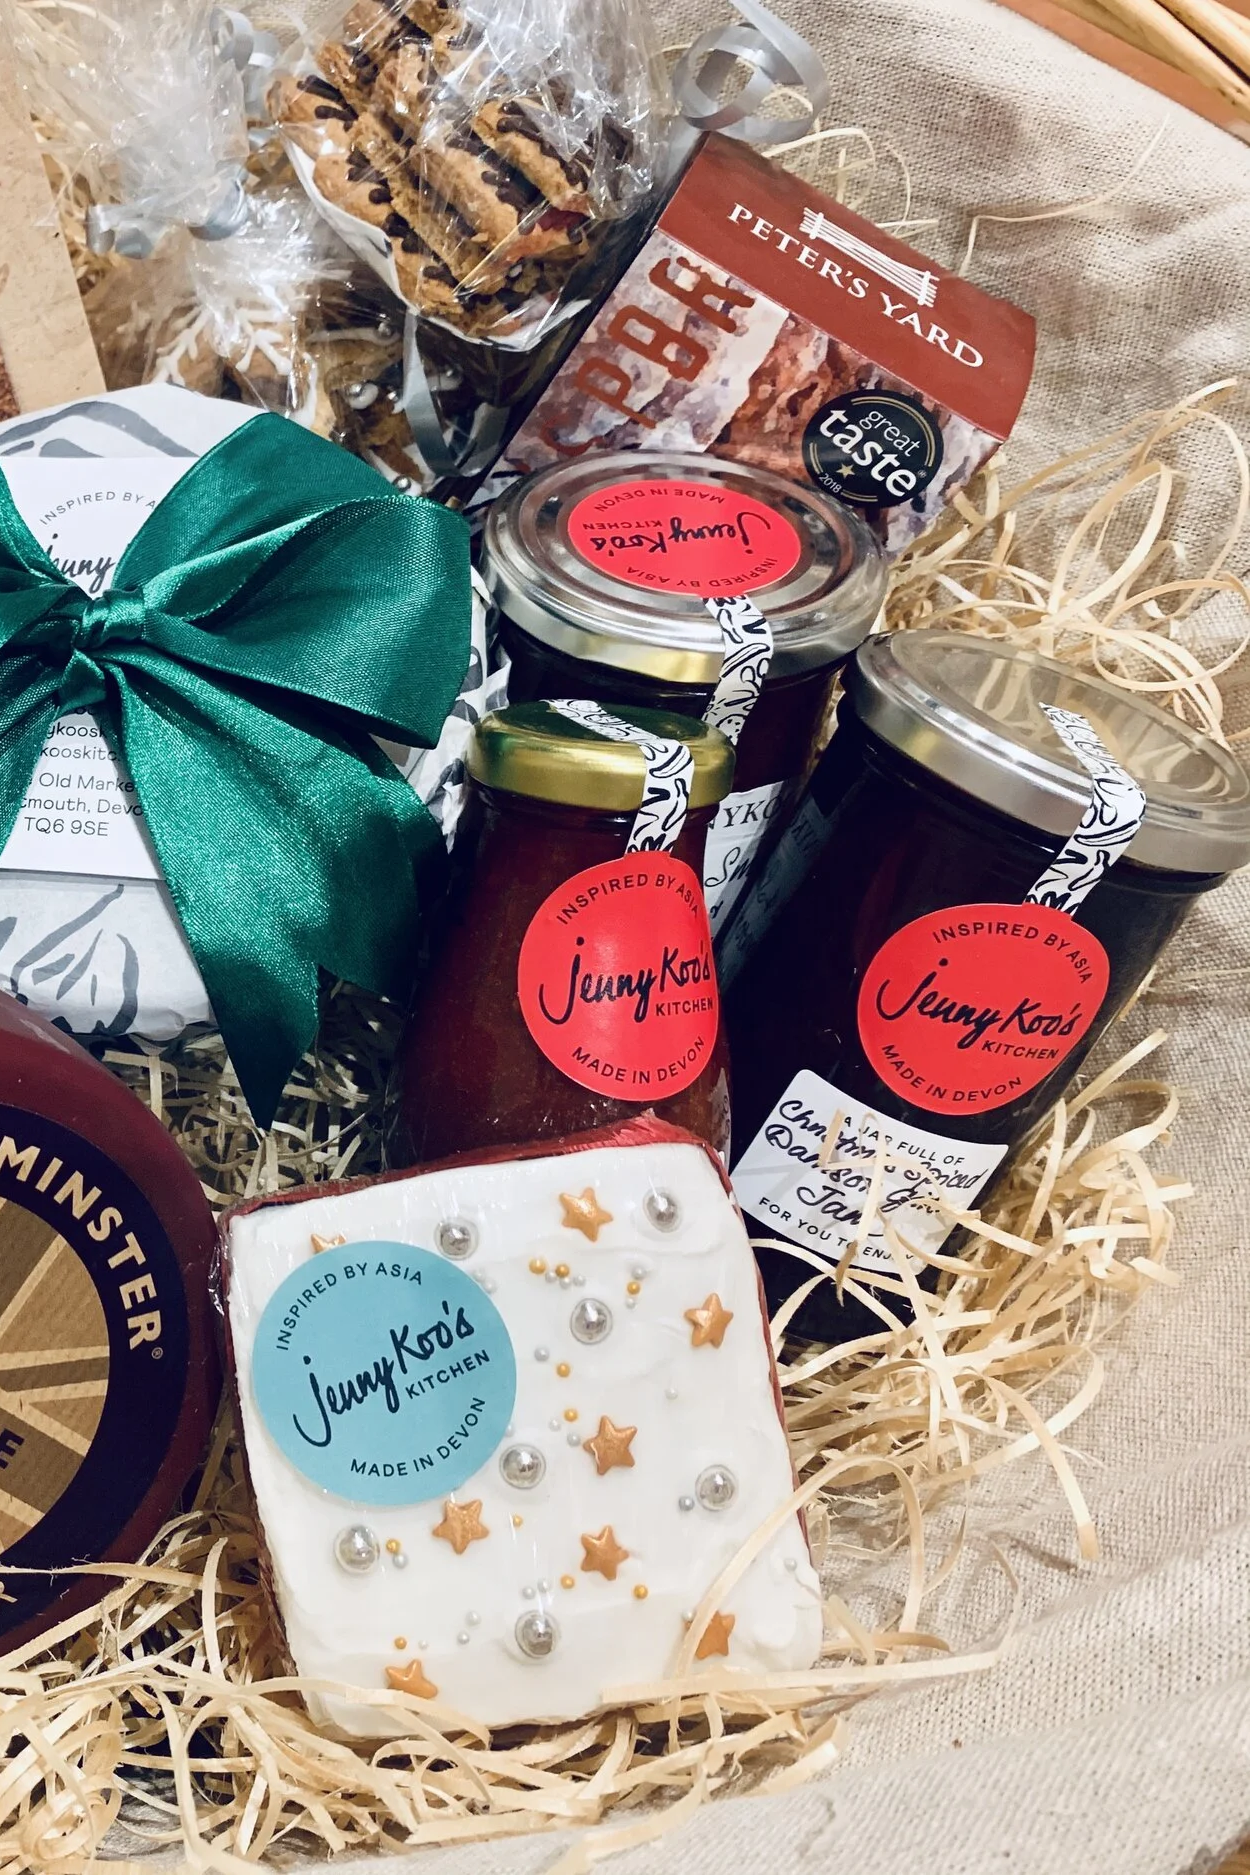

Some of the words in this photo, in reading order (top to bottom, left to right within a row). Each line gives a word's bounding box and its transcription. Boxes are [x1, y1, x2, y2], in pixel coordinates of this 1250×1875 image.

[726, 202, 870, 299] PETER'S
[879, 291, 984, 368] YARD
[859, 410, 921, 457] great
[819, 409, 917, 497] taste
[650, 487, 669, 496] IN
[674, 487, 725, 504] MADE
[818, 472, 842, 494] 2018
[39, 491, 116, 526] INSPIRED
[122, 492, 145, 504] BY
[593, 488, 646, 513] DEVON
[582, 519, 662, 531] KITCHEN
[625, 566, 670, 584] ASIA
[677, 580, 701, 588] BY
[709, 557, 778, 587] INSPIRED
[38, 772, 72, 789] Old
[77, 774, 135, 793] Marke
[96, 798, 143, 817] Devo
[23, 816, 65, 835] TQ6
[70, 819, 110, 837] 9SE
[556, 873, 649, 925] INSPIRED
[654, 873, 677, 889] BY
[675, 884, 699, 919] ASIA
[932, 921, 1039, 944] INSPIRED
[1043, 933, 1070, 952] BY
[1065, 950, 1093, 984] ASIA
[655, 996, 714, 1017] KITCHEN
[571, 1046, 627, 1082] MADE
[631, 1070, 651, 1084] IN
[657, 1036, 705, 1082] DEVON
[981, 1039, 1060, 1060] KITCHEN
[881, 1044, 926, 1089] MADE
[926, 1083, 948, 1100] IN
[952, 1076, 1023, 1102] DEVON
[896, 1141, 936, 1162] FULL
[943, 1155, 965, 1166] OF
[758, 1196, 792, 1222] FOR
[798, 1218, 832, 1242] YOU
[275, 1272, 337, 1351] INSPIRED
[343, 1262, 368, 1280] BY
[375, 1261, 423, 1286] ASIA
[404, 1349, 491, 1400] KITCHEN
[350, 1458, 408, 1478] MADE
[412, 1453, 434, 1473] IN
[436, 1396, 486, 1461] DEVON
